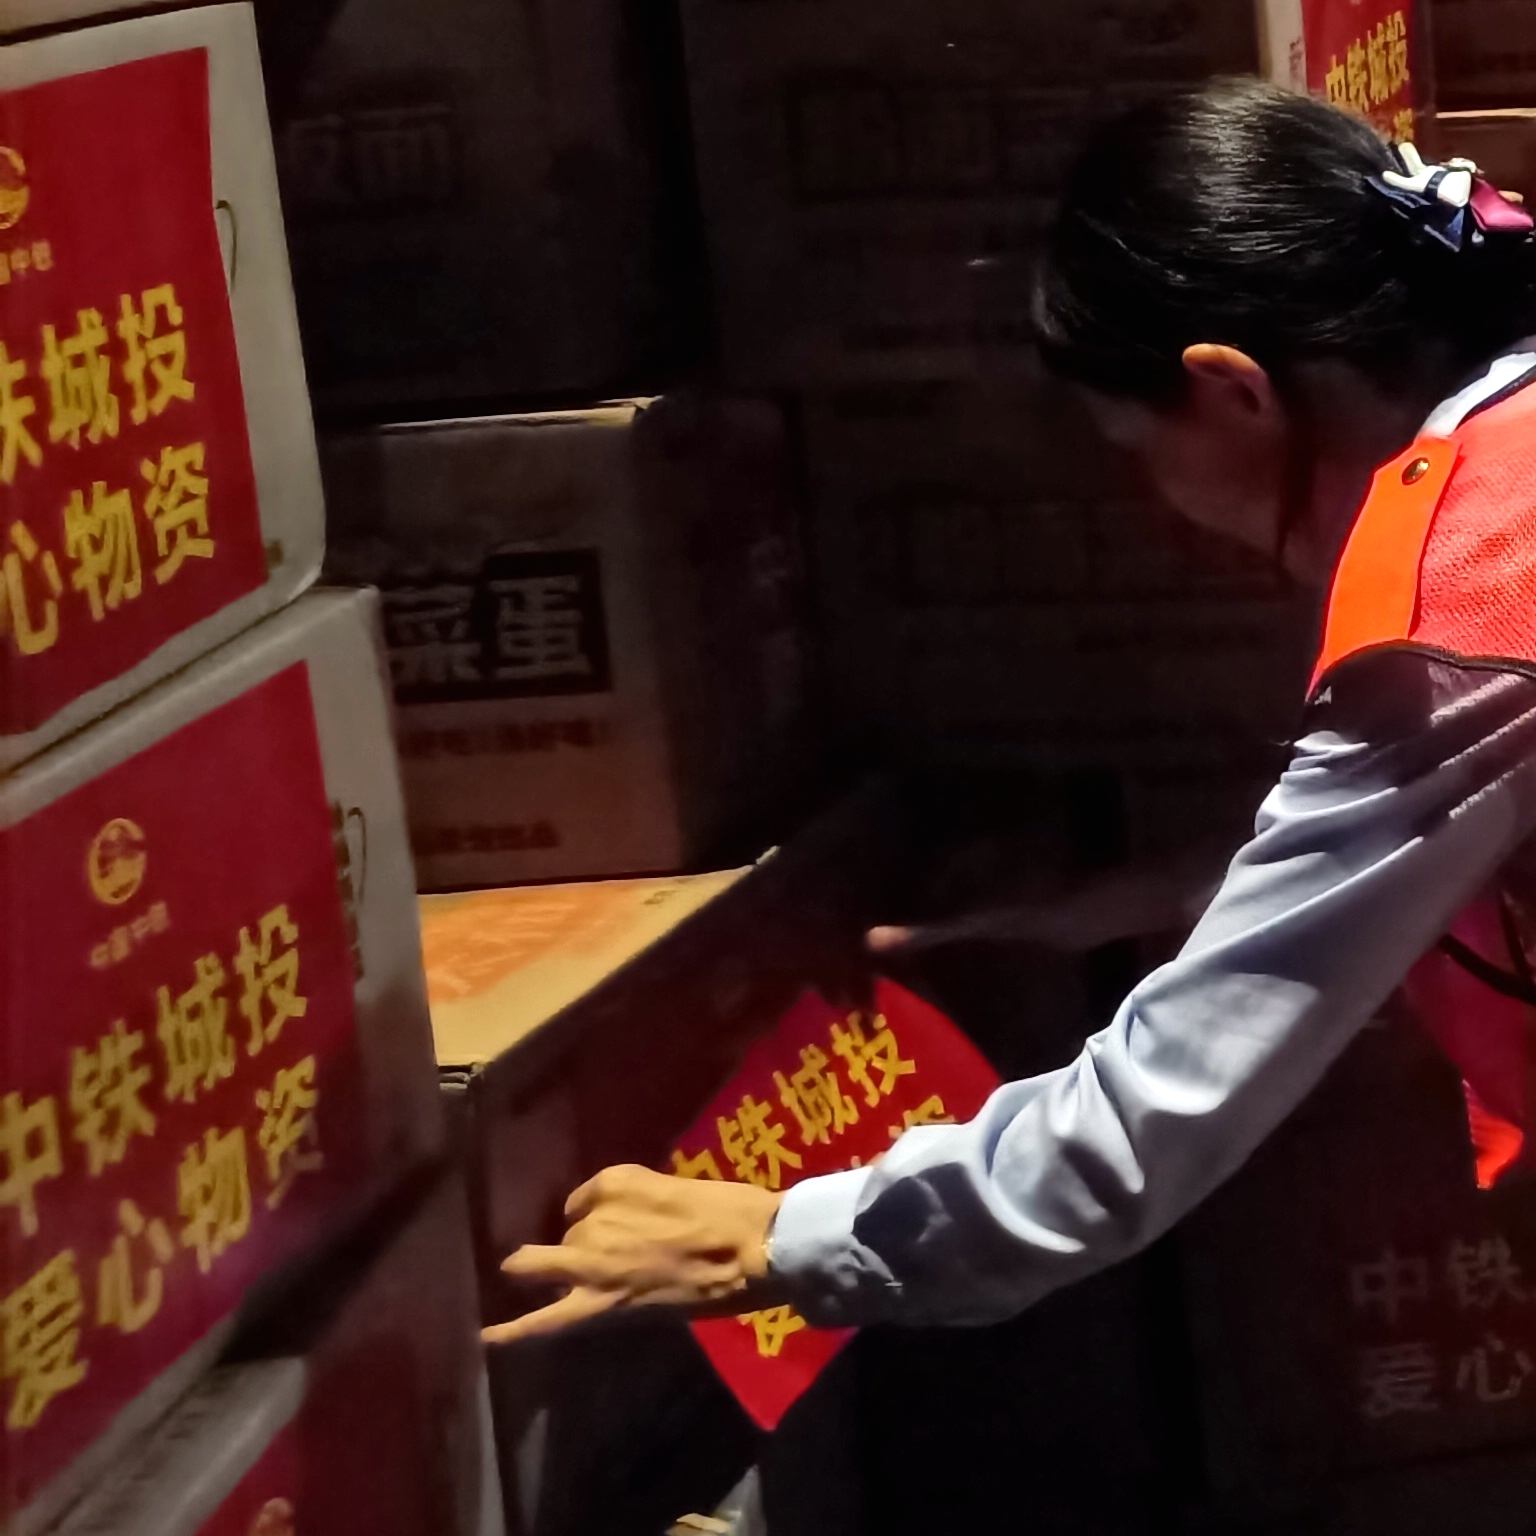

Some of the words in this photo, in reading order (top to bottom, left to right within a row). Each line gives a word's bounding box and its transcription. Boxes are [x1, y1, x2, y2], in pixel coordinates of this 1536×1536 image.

[0, 904, 308, 1238] 中铁城投
[0, 1055, 325, 1431] 爱心物资
